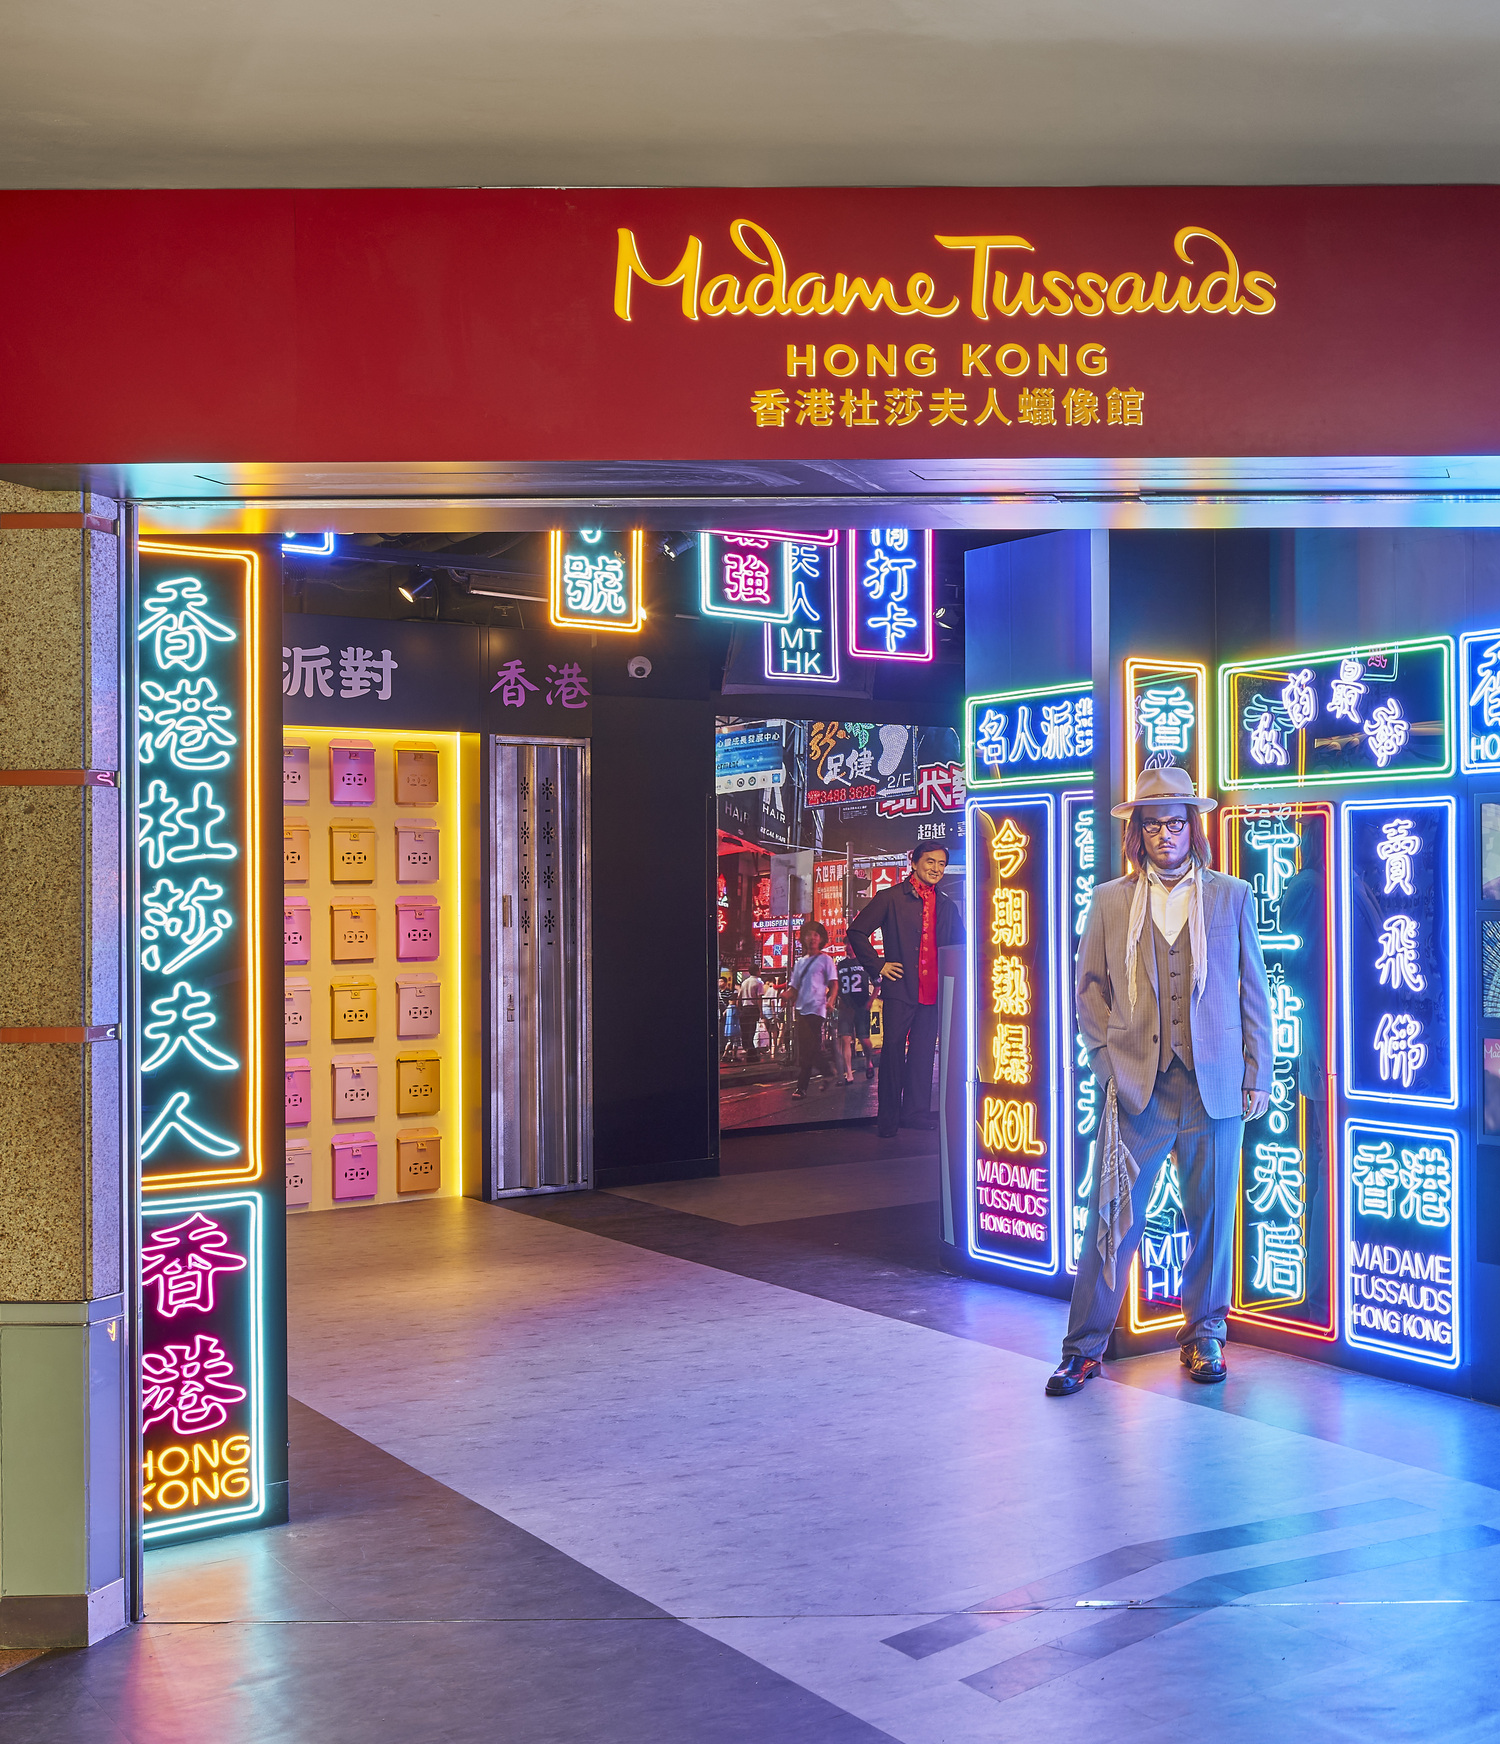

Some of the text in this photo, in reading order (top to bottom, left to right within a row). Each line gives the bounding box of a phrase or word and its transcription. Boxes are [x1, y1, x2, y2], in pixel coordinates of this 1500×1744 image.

[613, 217, 1278, 321] Madame Tussauds
[785, 341, 1109, 378] HONG KONG
[749, 385, 1146, 428] 香港杜莎夫人蠟像館
[780, 627, 823, 651] MT
[283, 645, 398, 701] 派對
[782, 650, 822, 674] HK
[490, 659, 591, 710] 香港
[887, 772, 911, 789] 2/F
[762, 803, 786, 824] HAIR
[139, 575, 240, 1157] 香港杜莎夫人
[991, 818, 1032, 1085] 今期熱爆
[1373, 817, 1428, 1089] 賣飛佛
[841, 974, 863, 994] 32
[983, 1096, 1045, 1156] KOL
[976, 1158, 1049, 1192] MADAME
[1352, 1141, 1452, 1228] 香港
[976, 1186, 1049, 1217] TUSSAUDS
[979, 1211, 1048, 1242] HONG KONG
[1144, 1231, 1190, 1269] MT
[1350, 1240, 1453, 1286] MADAME
[1351, 1272, 1453, 1316] TUSSAUDS
[141, 1212, 248, 1436] 香港
[1353, 1303, 1453, 1345] HONG KONG
